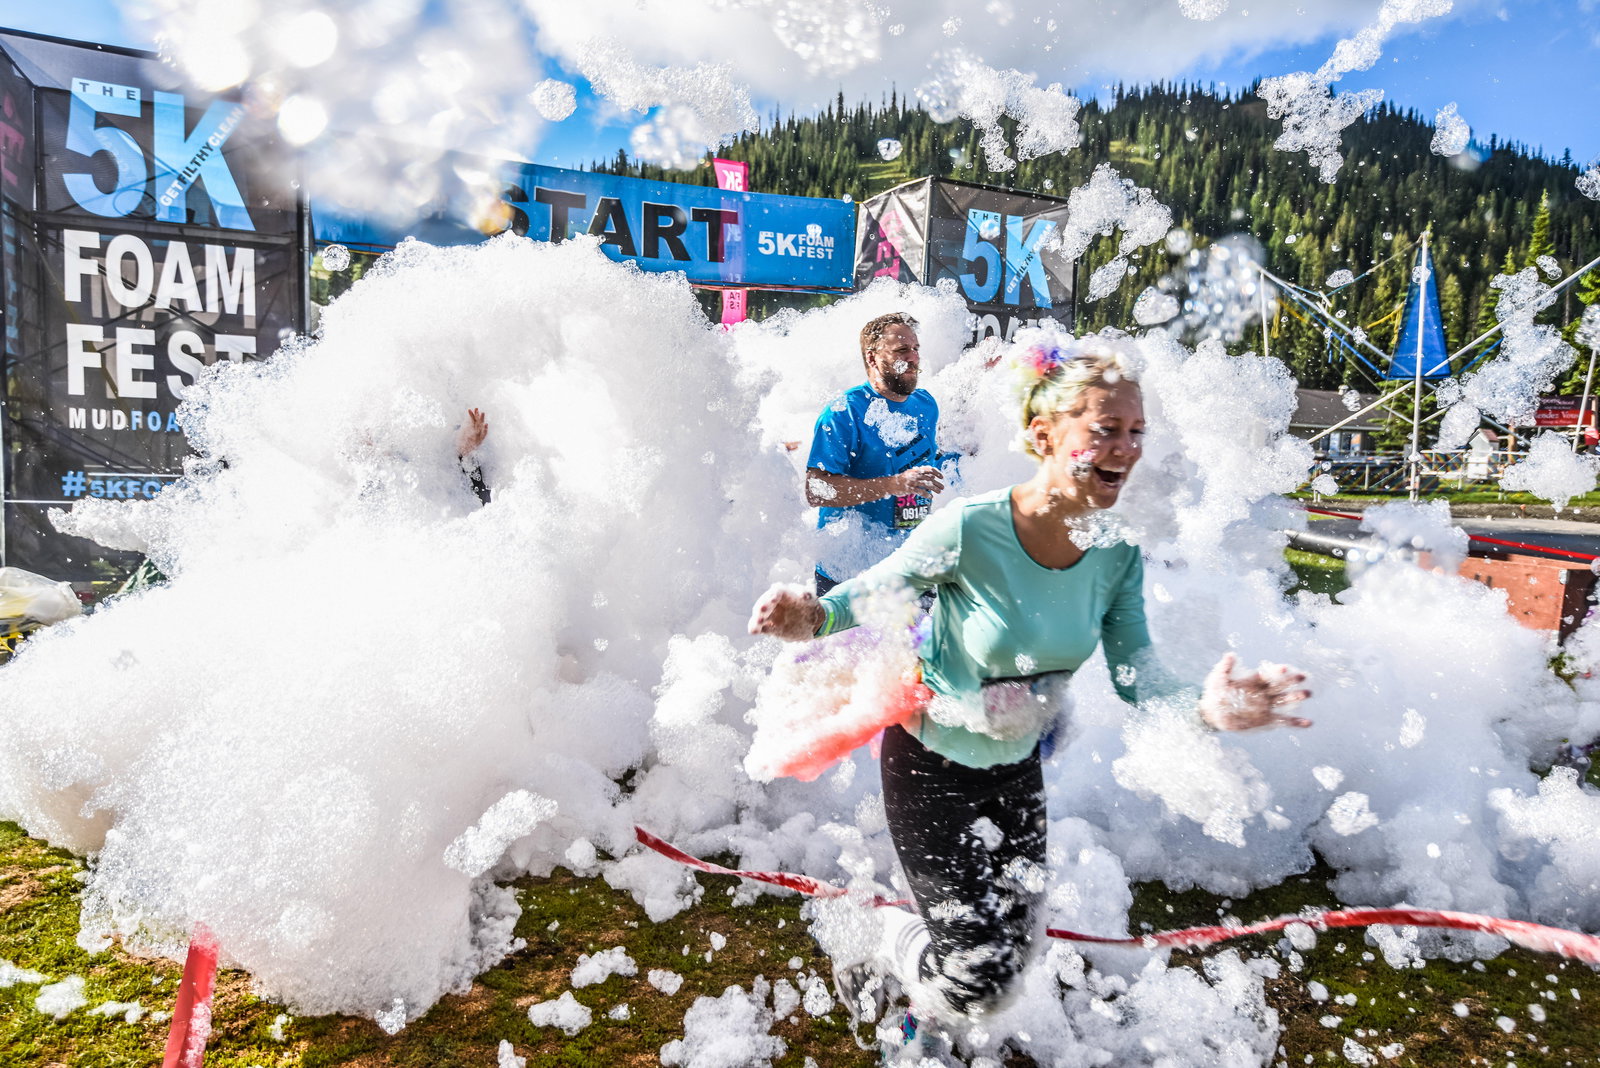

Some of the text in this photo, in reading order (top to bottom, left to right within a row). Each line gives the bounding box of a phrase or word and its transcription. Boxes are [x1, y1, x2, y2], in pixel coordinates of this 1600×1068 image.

[78, 82, 137, 101] THE
[62, 77, 256, 231] 5K
[972, 210, 999, 223] THE
[758, 230, 799, 257] 5K
[798, 232, 835, 248] FOAM
[798, 246, 834, 260] FEST
[63, 228, 257, 316] FOAM
[960, 208, 1057, 310] 5K
[61, 471, 175, 499] #5KFO
